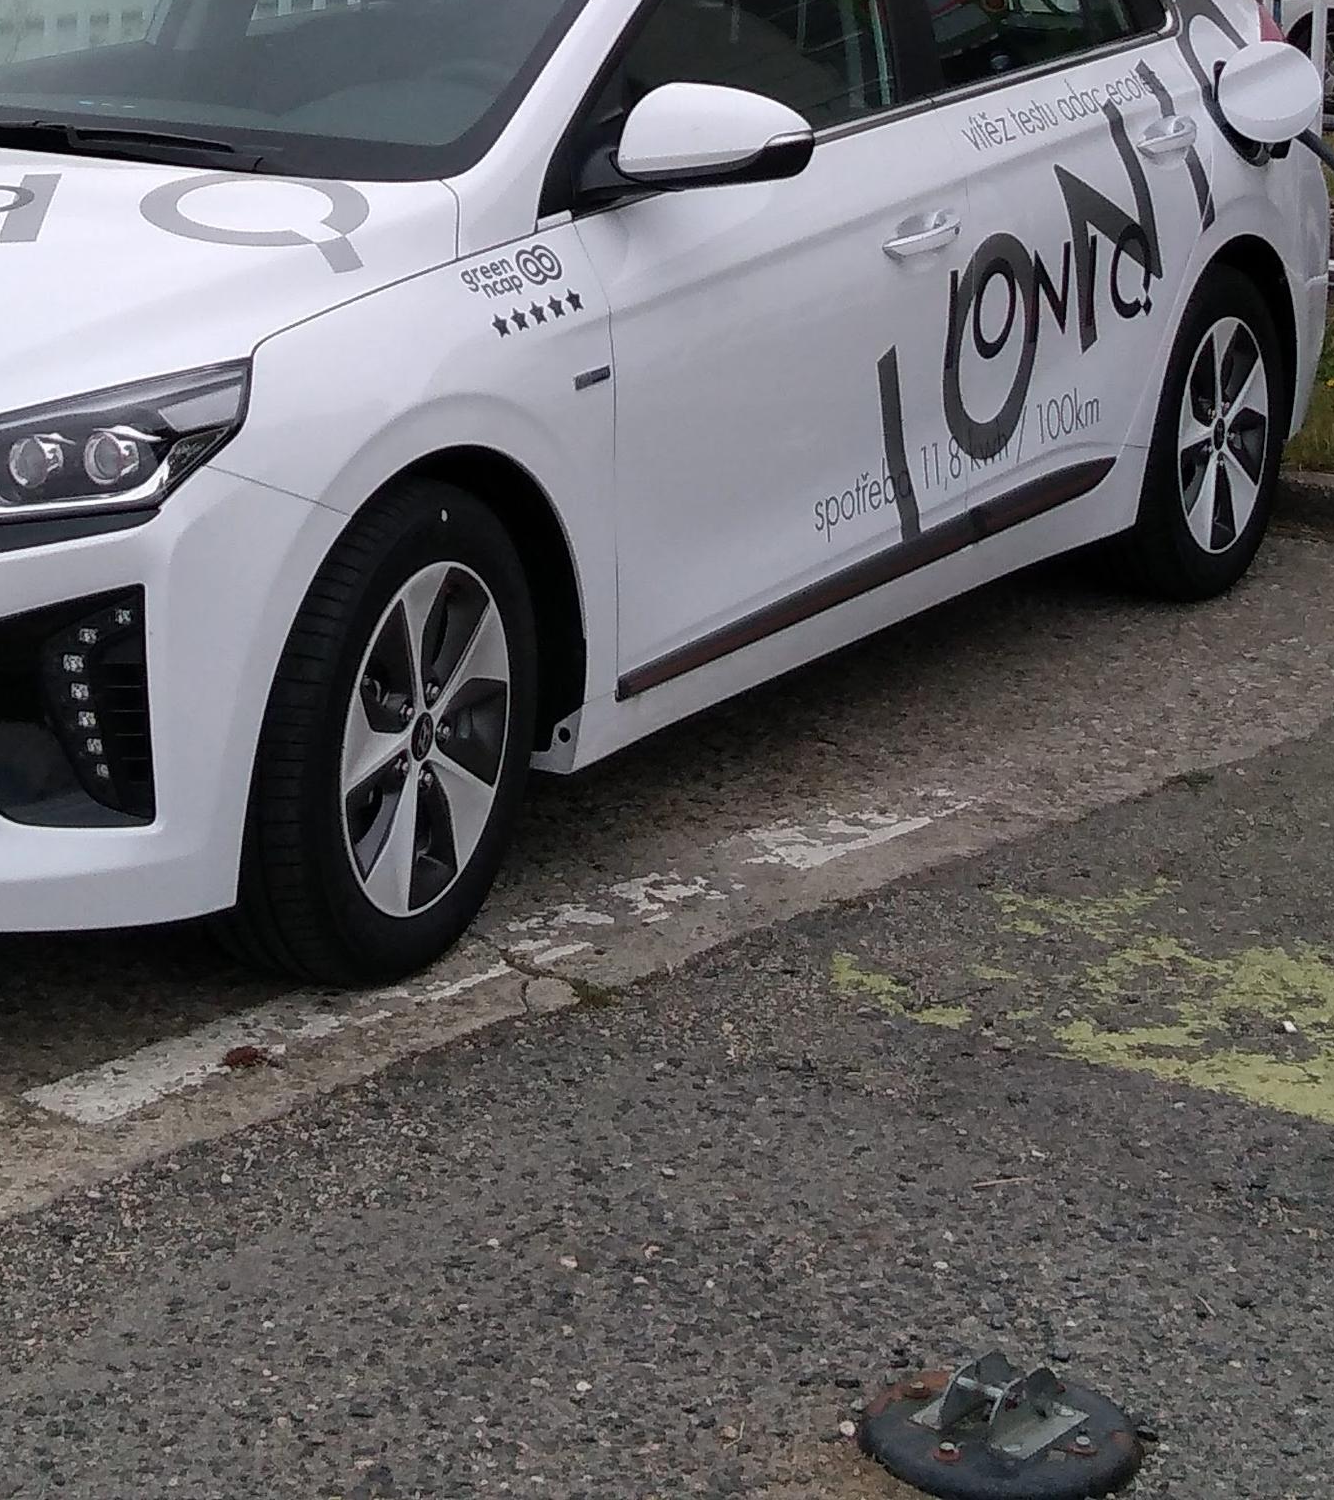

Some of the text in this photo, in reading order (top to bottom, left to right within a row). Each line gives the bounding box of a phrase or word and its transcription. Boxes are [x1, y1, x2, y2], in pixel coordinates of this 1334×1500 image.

[1006, 99, 1059, 137] testu
[1056, 78, 1104, 122] adac
[460, 258, 515, 293] green
[480, 274, 524, 299] ncap
[943, 221, 1153, 370] IONIQ
[813, 456, 914, 543] spotřeba
[920, 435, 963, 492] 11,8
[1036, 387, 1101, 445] 100km
